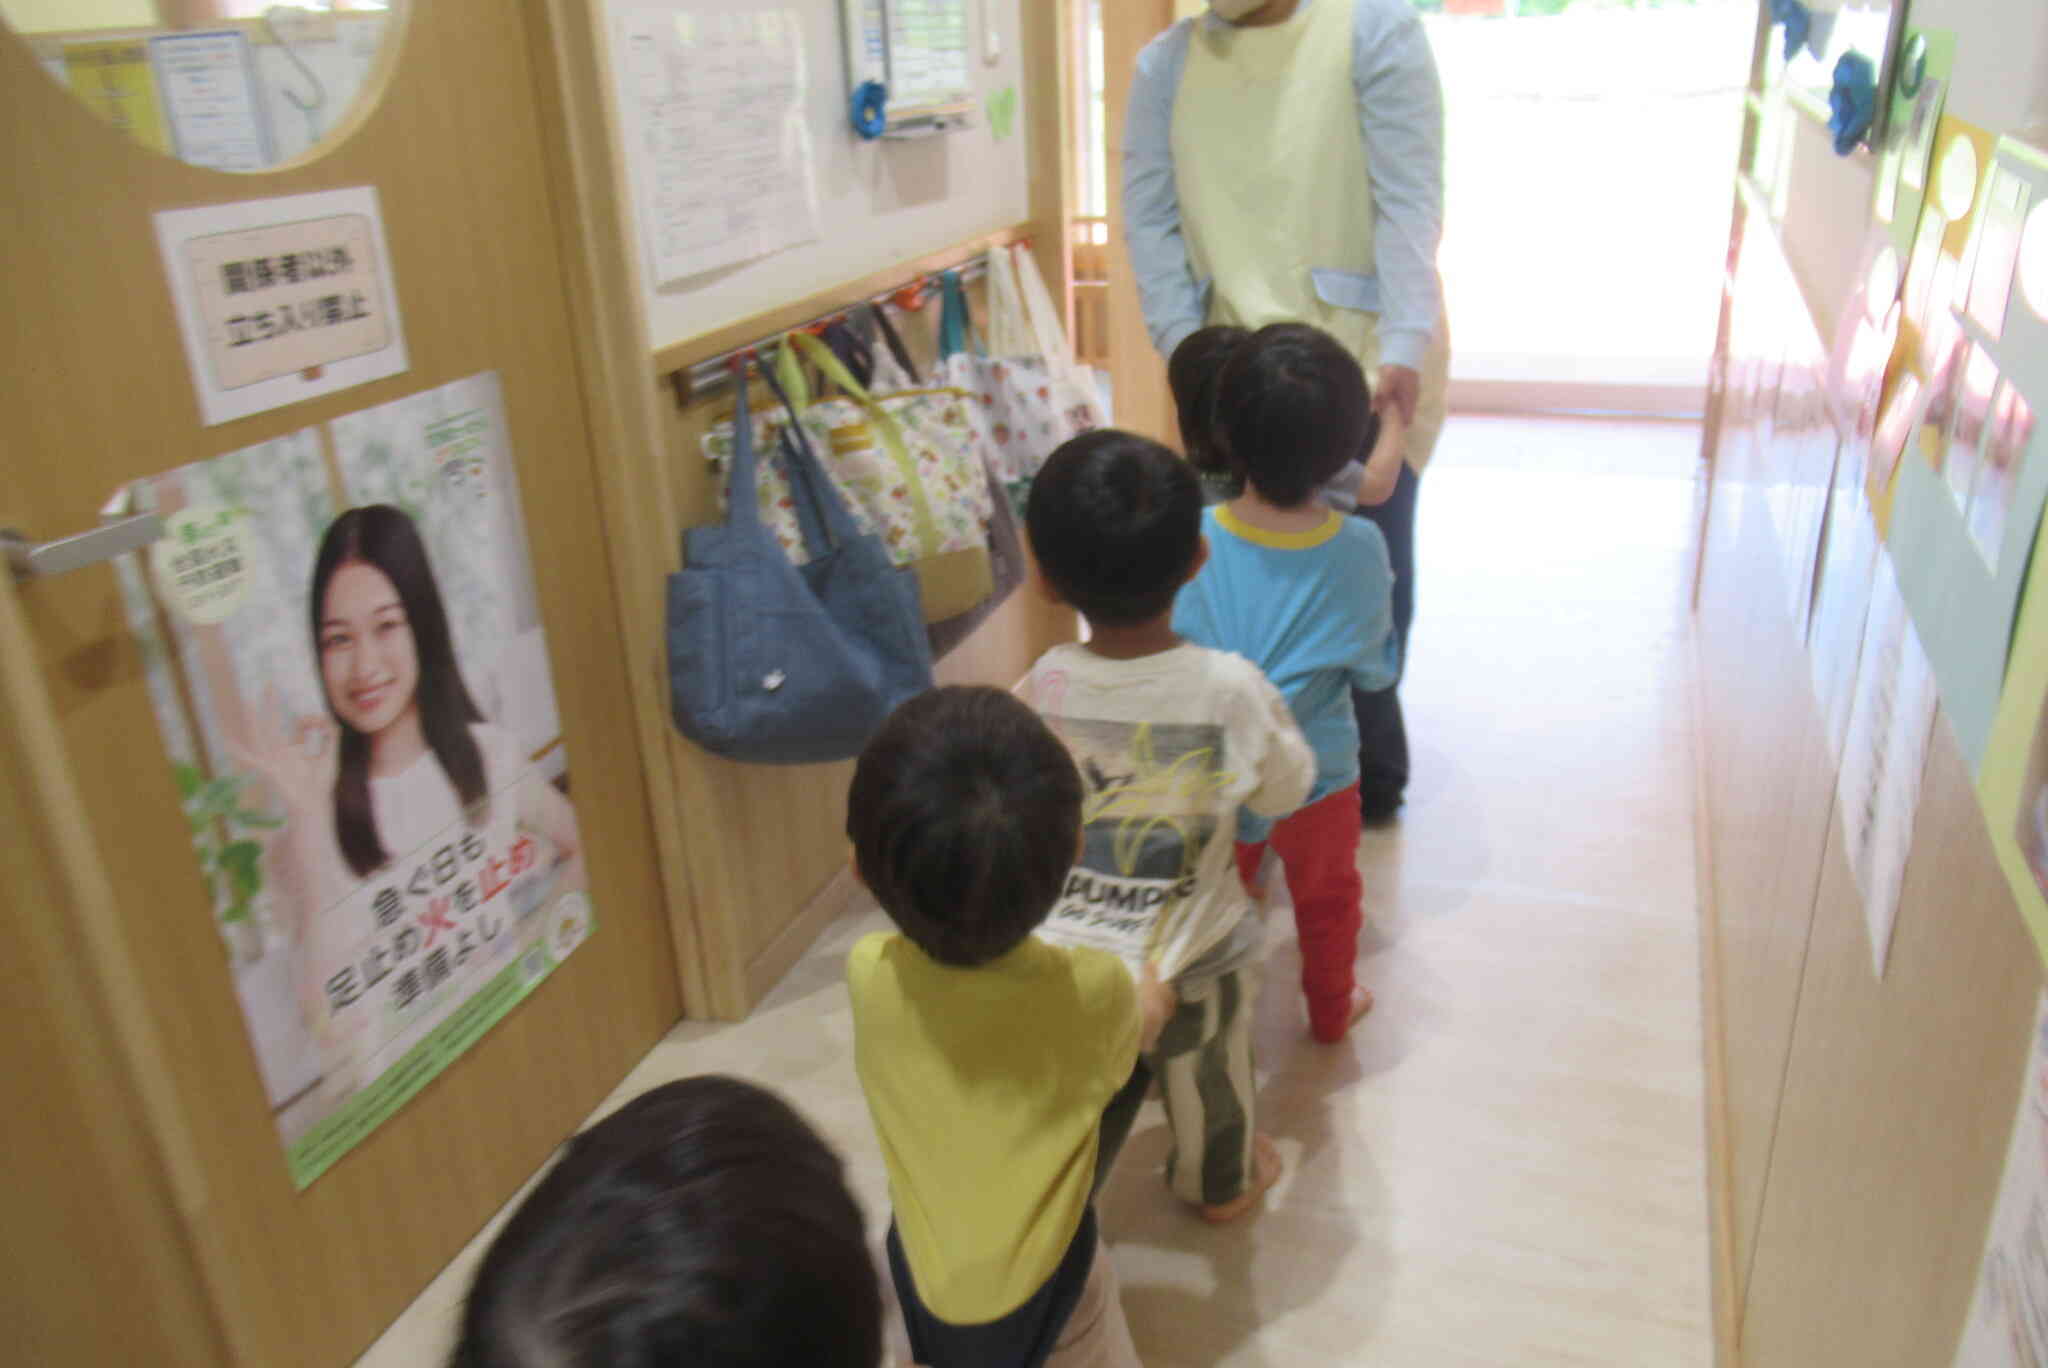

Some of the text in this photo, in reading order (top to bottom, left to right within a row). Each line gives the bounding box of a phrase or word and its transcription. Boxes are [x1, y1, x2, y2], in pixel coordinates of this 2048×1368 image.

[221, 247, 354, 294] 関係者以外
[224, 294, 372, 346] 立ち入り禁止
[371, 833, 485, 927] 急ぐ日も
